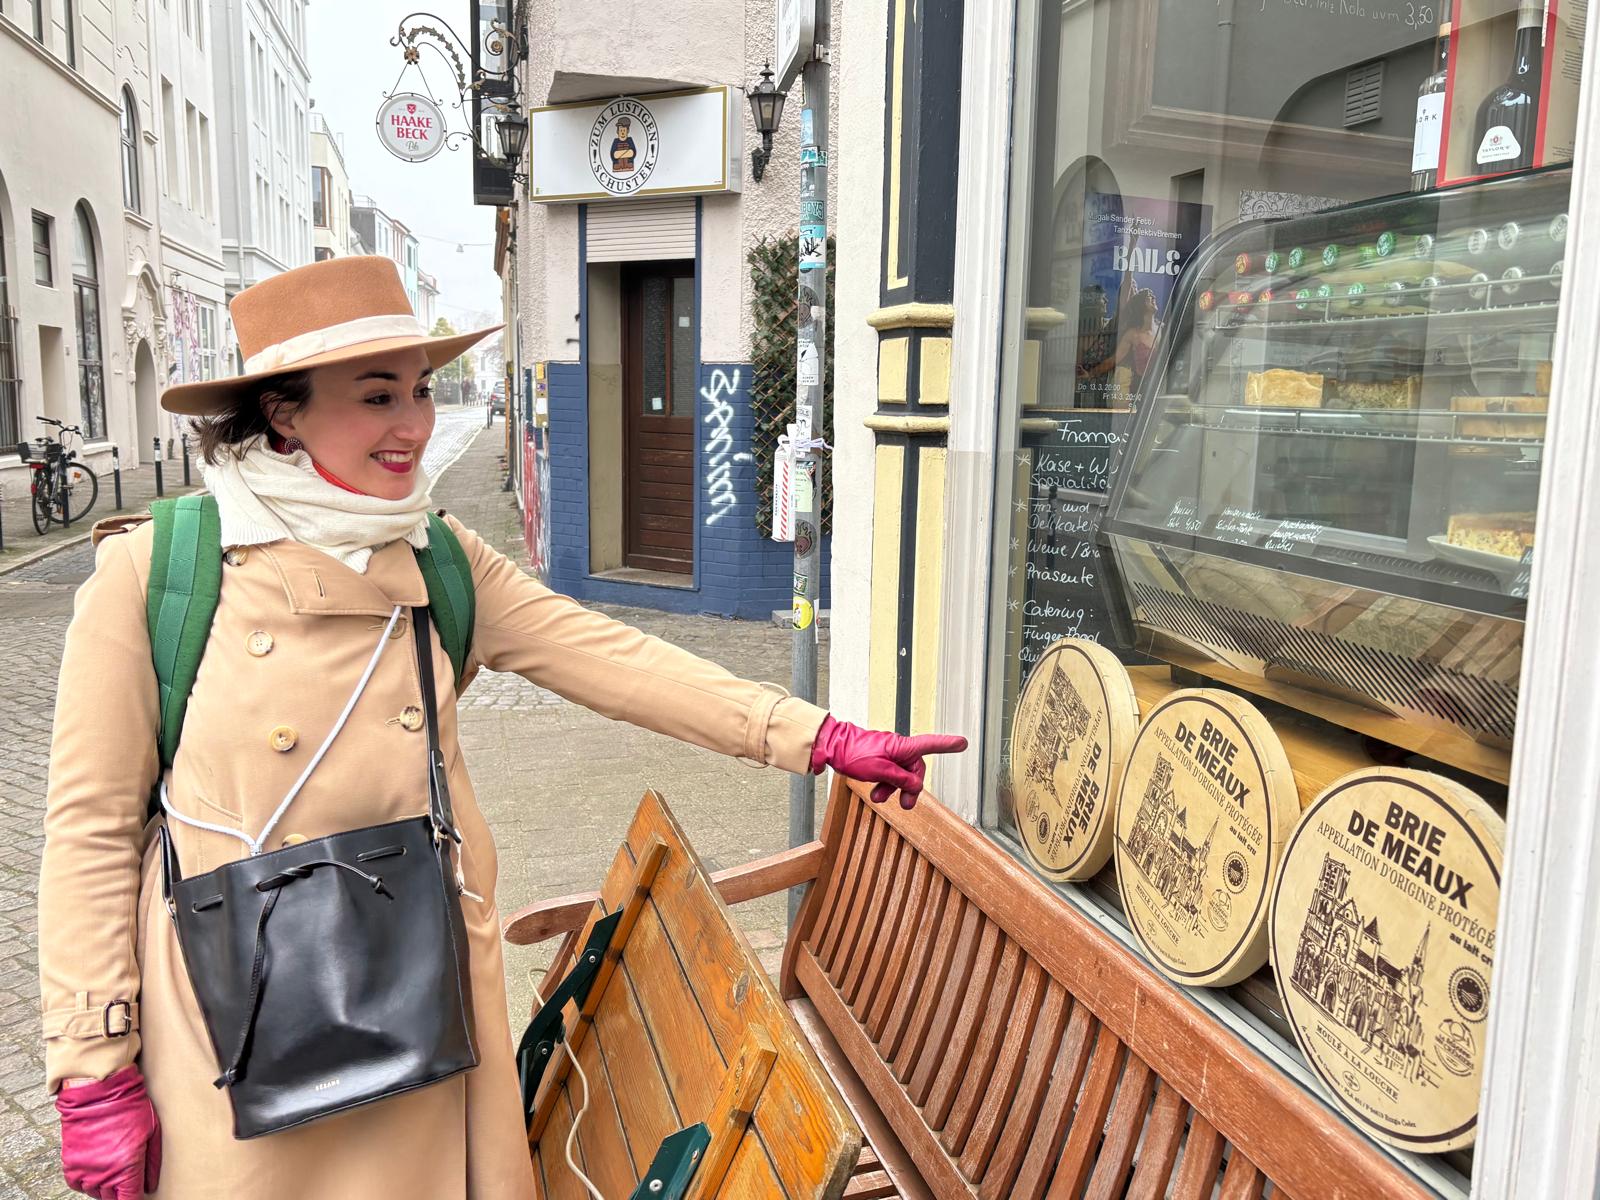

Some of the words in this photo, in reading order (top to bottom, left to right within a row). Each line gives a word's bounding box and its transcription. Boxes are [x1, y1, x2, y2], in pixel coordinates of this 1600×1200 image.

[1404, 2, 1434, 30] 3,50
[391, 114, 433, 129] HAAKE
[396, 127, 429, 140] BECK
[589, 115, 608, 147] ZUM
[610, 102, 657, 142] LUSTIGEN
[594, 161, 654, 192] SCHUSTER
[1112, 245, 1180, 276] BAILE
[1087, 741, 1102, 774] DE
[1175, 721, 1197, 753] DE
[1195, 742, 1250, 810] MEAUX
[1200, 718, 1239, 767] BRIE
[1079, 781, 1100, 835] BRIE
[1154, 726, 1194, 775] APPELLATION
[1192, 765, 1226, 808] D'ORIGINE
[1224, 800, 1263, 846] PROTÉGÉE
[1063, 773, 1091, 848] MEAUX
[1384, 801, 1446, 856] BRIE
[1229, 825, 1237, 836] au
[1237, 831, 1247, 847] lait
[1246, 843, 1257, 856] cru
[1347, 809, 1380, 848] DE
[1381, 831, 1474, 909] MEAUX
[1317, 820, 1377, 871] APPELLATION
[1380, 863, 1436, 911] D'ORIGINE
[1437, 903, 1496, 949] PROTÉGÉ
[1449, 932, 1461, 945] au
[1464, 939, 1479, 957] lait
[1316, 1024, 1342, 1050] MOULÉ
[1351, 1055, 1362, 1070] LA
[1363, 1068, 1399, 1100] LOUCHE
